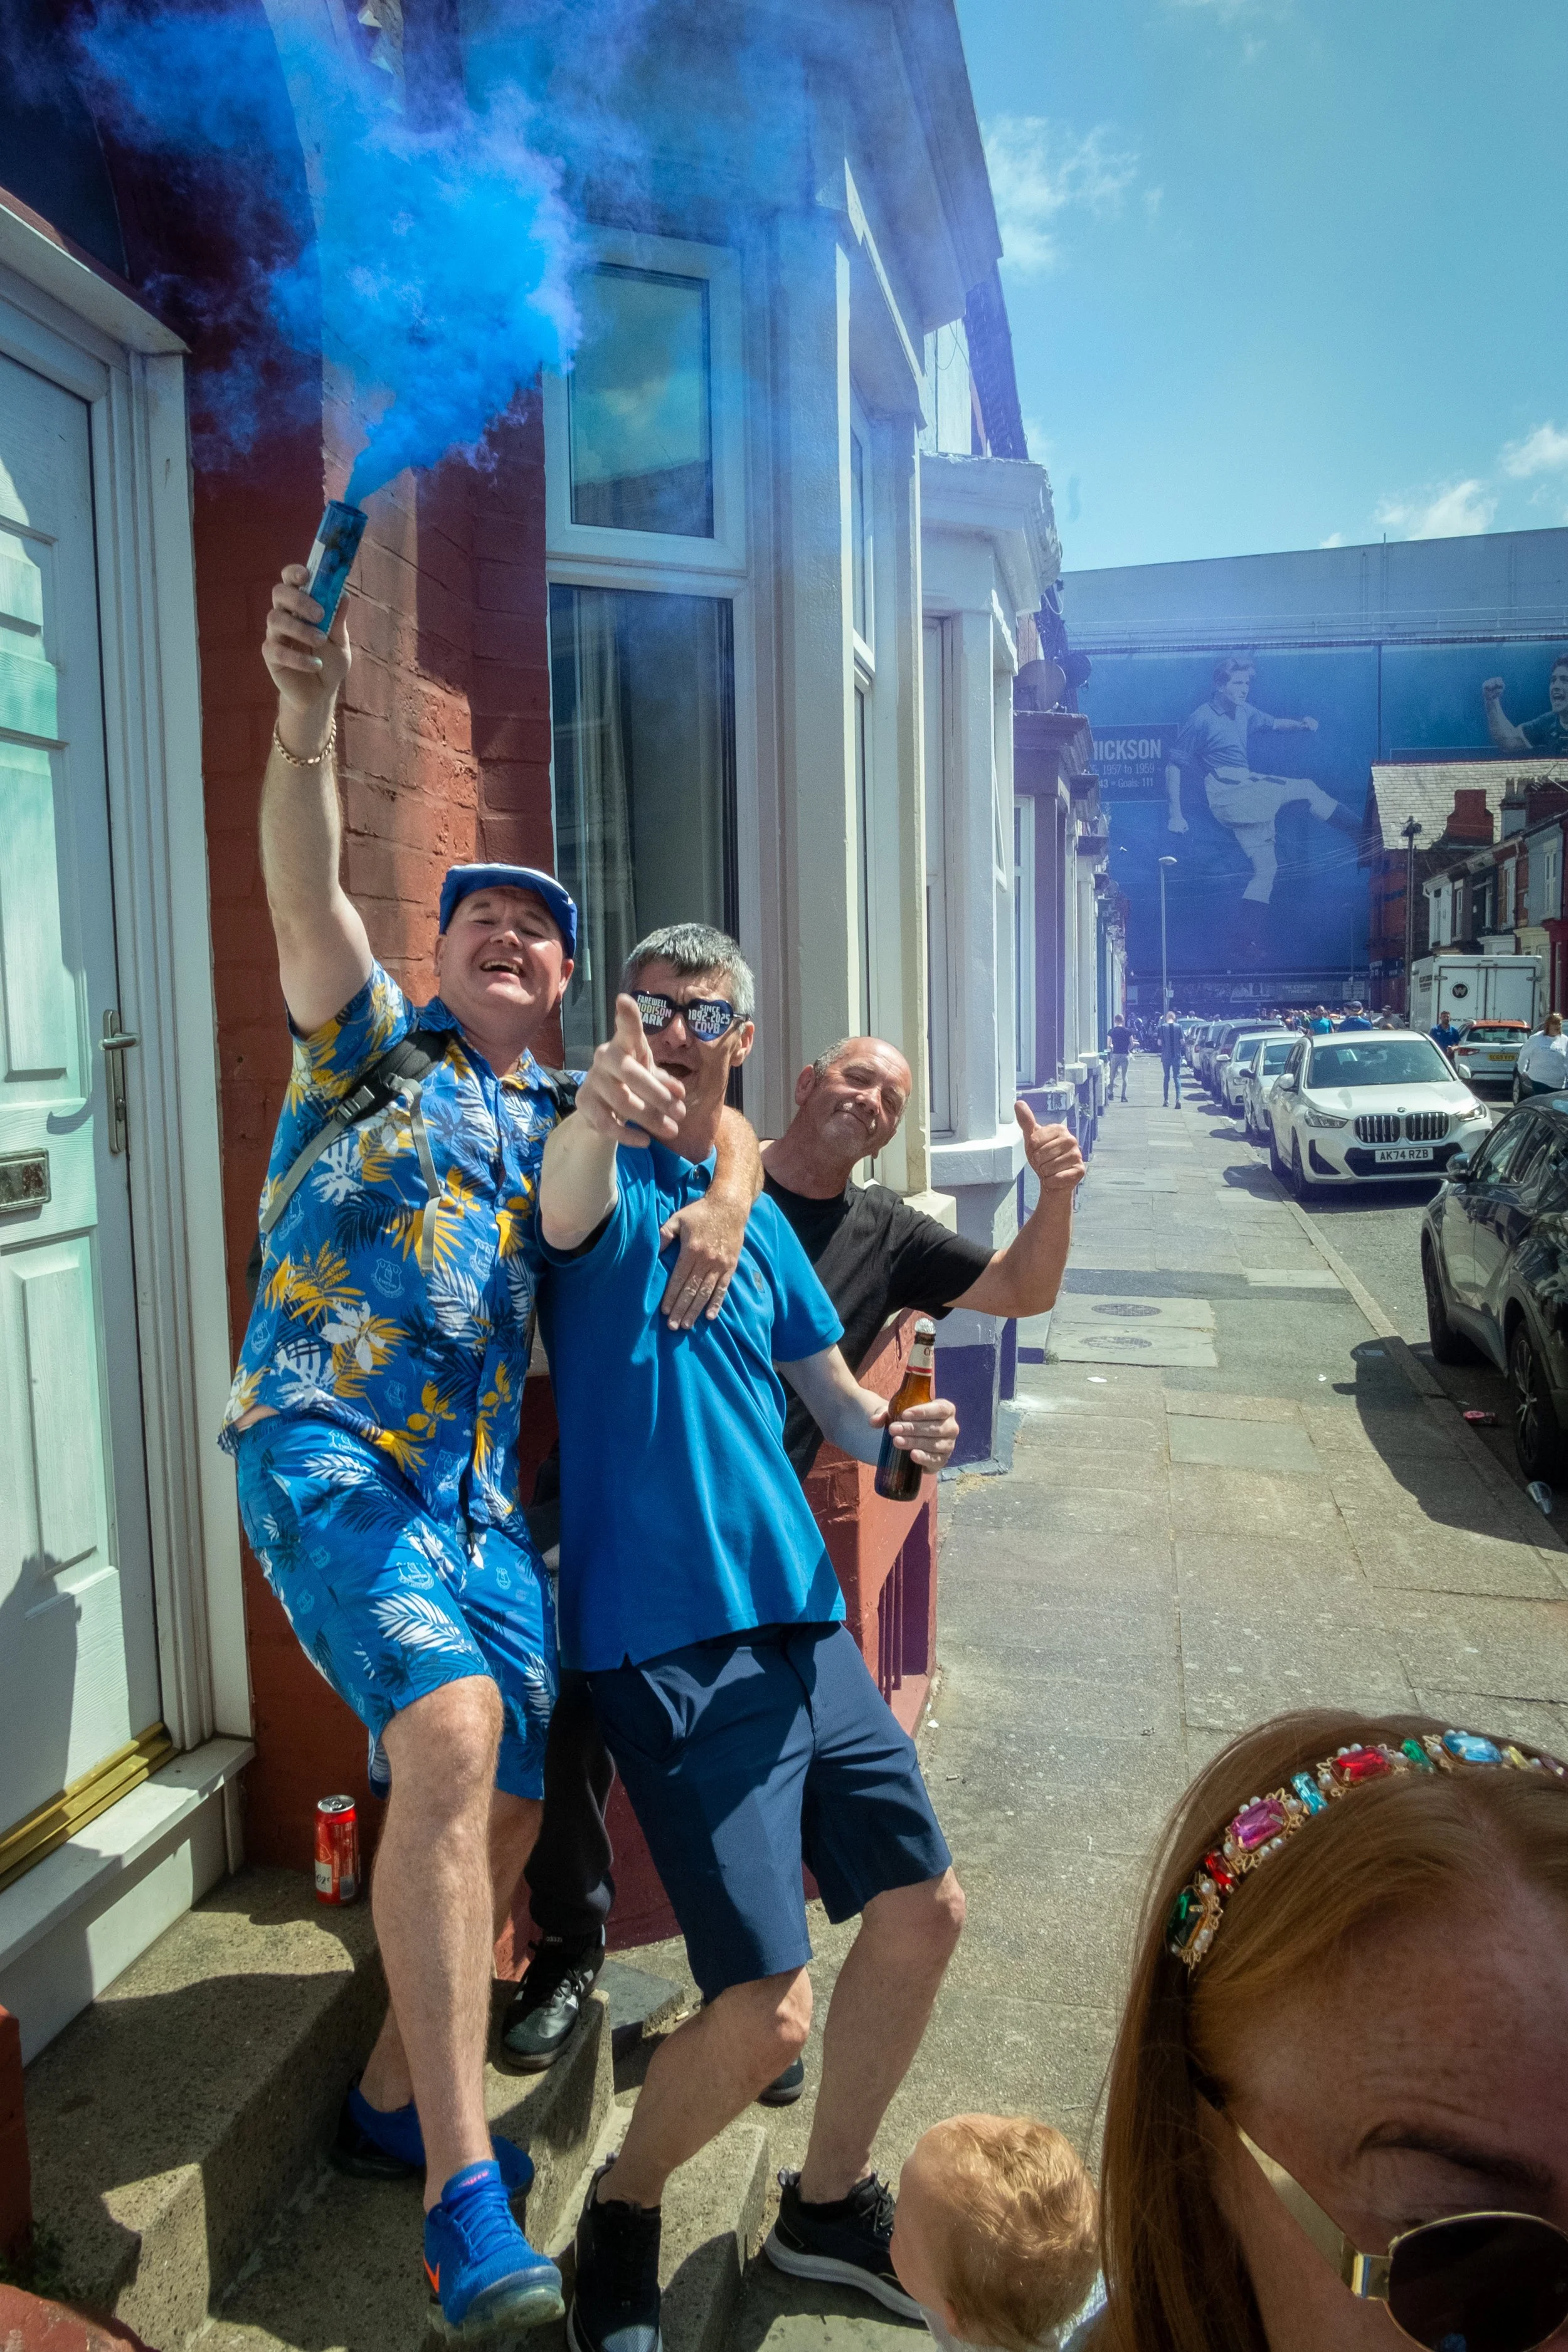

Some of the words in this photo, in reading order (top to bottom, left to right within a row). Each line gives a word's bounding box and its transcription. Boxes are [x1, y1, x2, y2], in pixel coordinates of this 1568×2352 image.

[1103, 764, 1121, 775] 1957
[1124, 763, 1133, 774] to
[1136, 763, 1155, 774] 1959
[637, 995, 667, 1008] FAREWELL
[637, 1002, 672, 1019] ODISON
[699, 1004, 721, 1014] SINCE
[688, 1009, 731, 1024] 1892-2025
[695, 1021, 721, 1034] COYB
[1380, 1150, 1406, 1161] AK74
[1409, 1149, 1429, 1159] RZB
